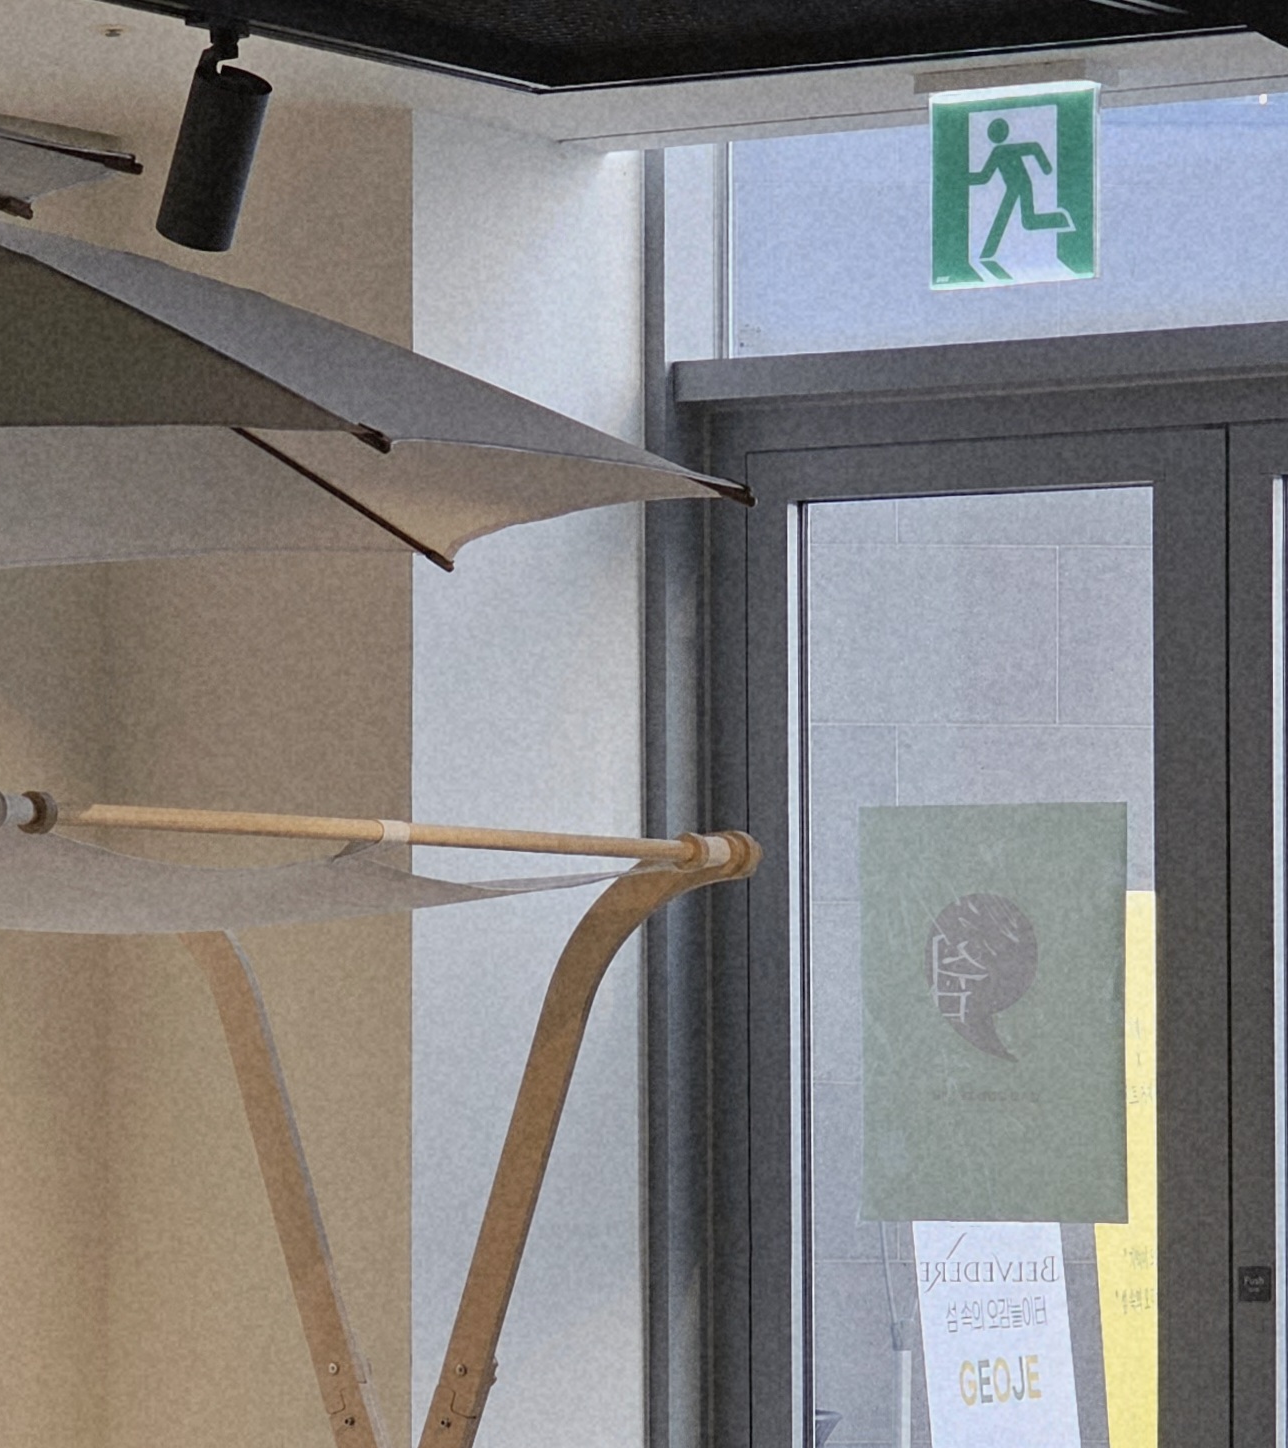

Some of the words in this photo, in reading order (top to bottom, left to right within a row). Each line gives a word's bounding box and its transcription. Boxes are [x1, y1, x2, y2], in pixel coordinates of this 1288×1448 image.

[945, 1301, 959, 1333] 섬
[960, 1298, 985, 1331] 속의
[986, 1294, 1048, 1329] 오감놀이터
[959, 1354, 1042, 1406] GEOJE
